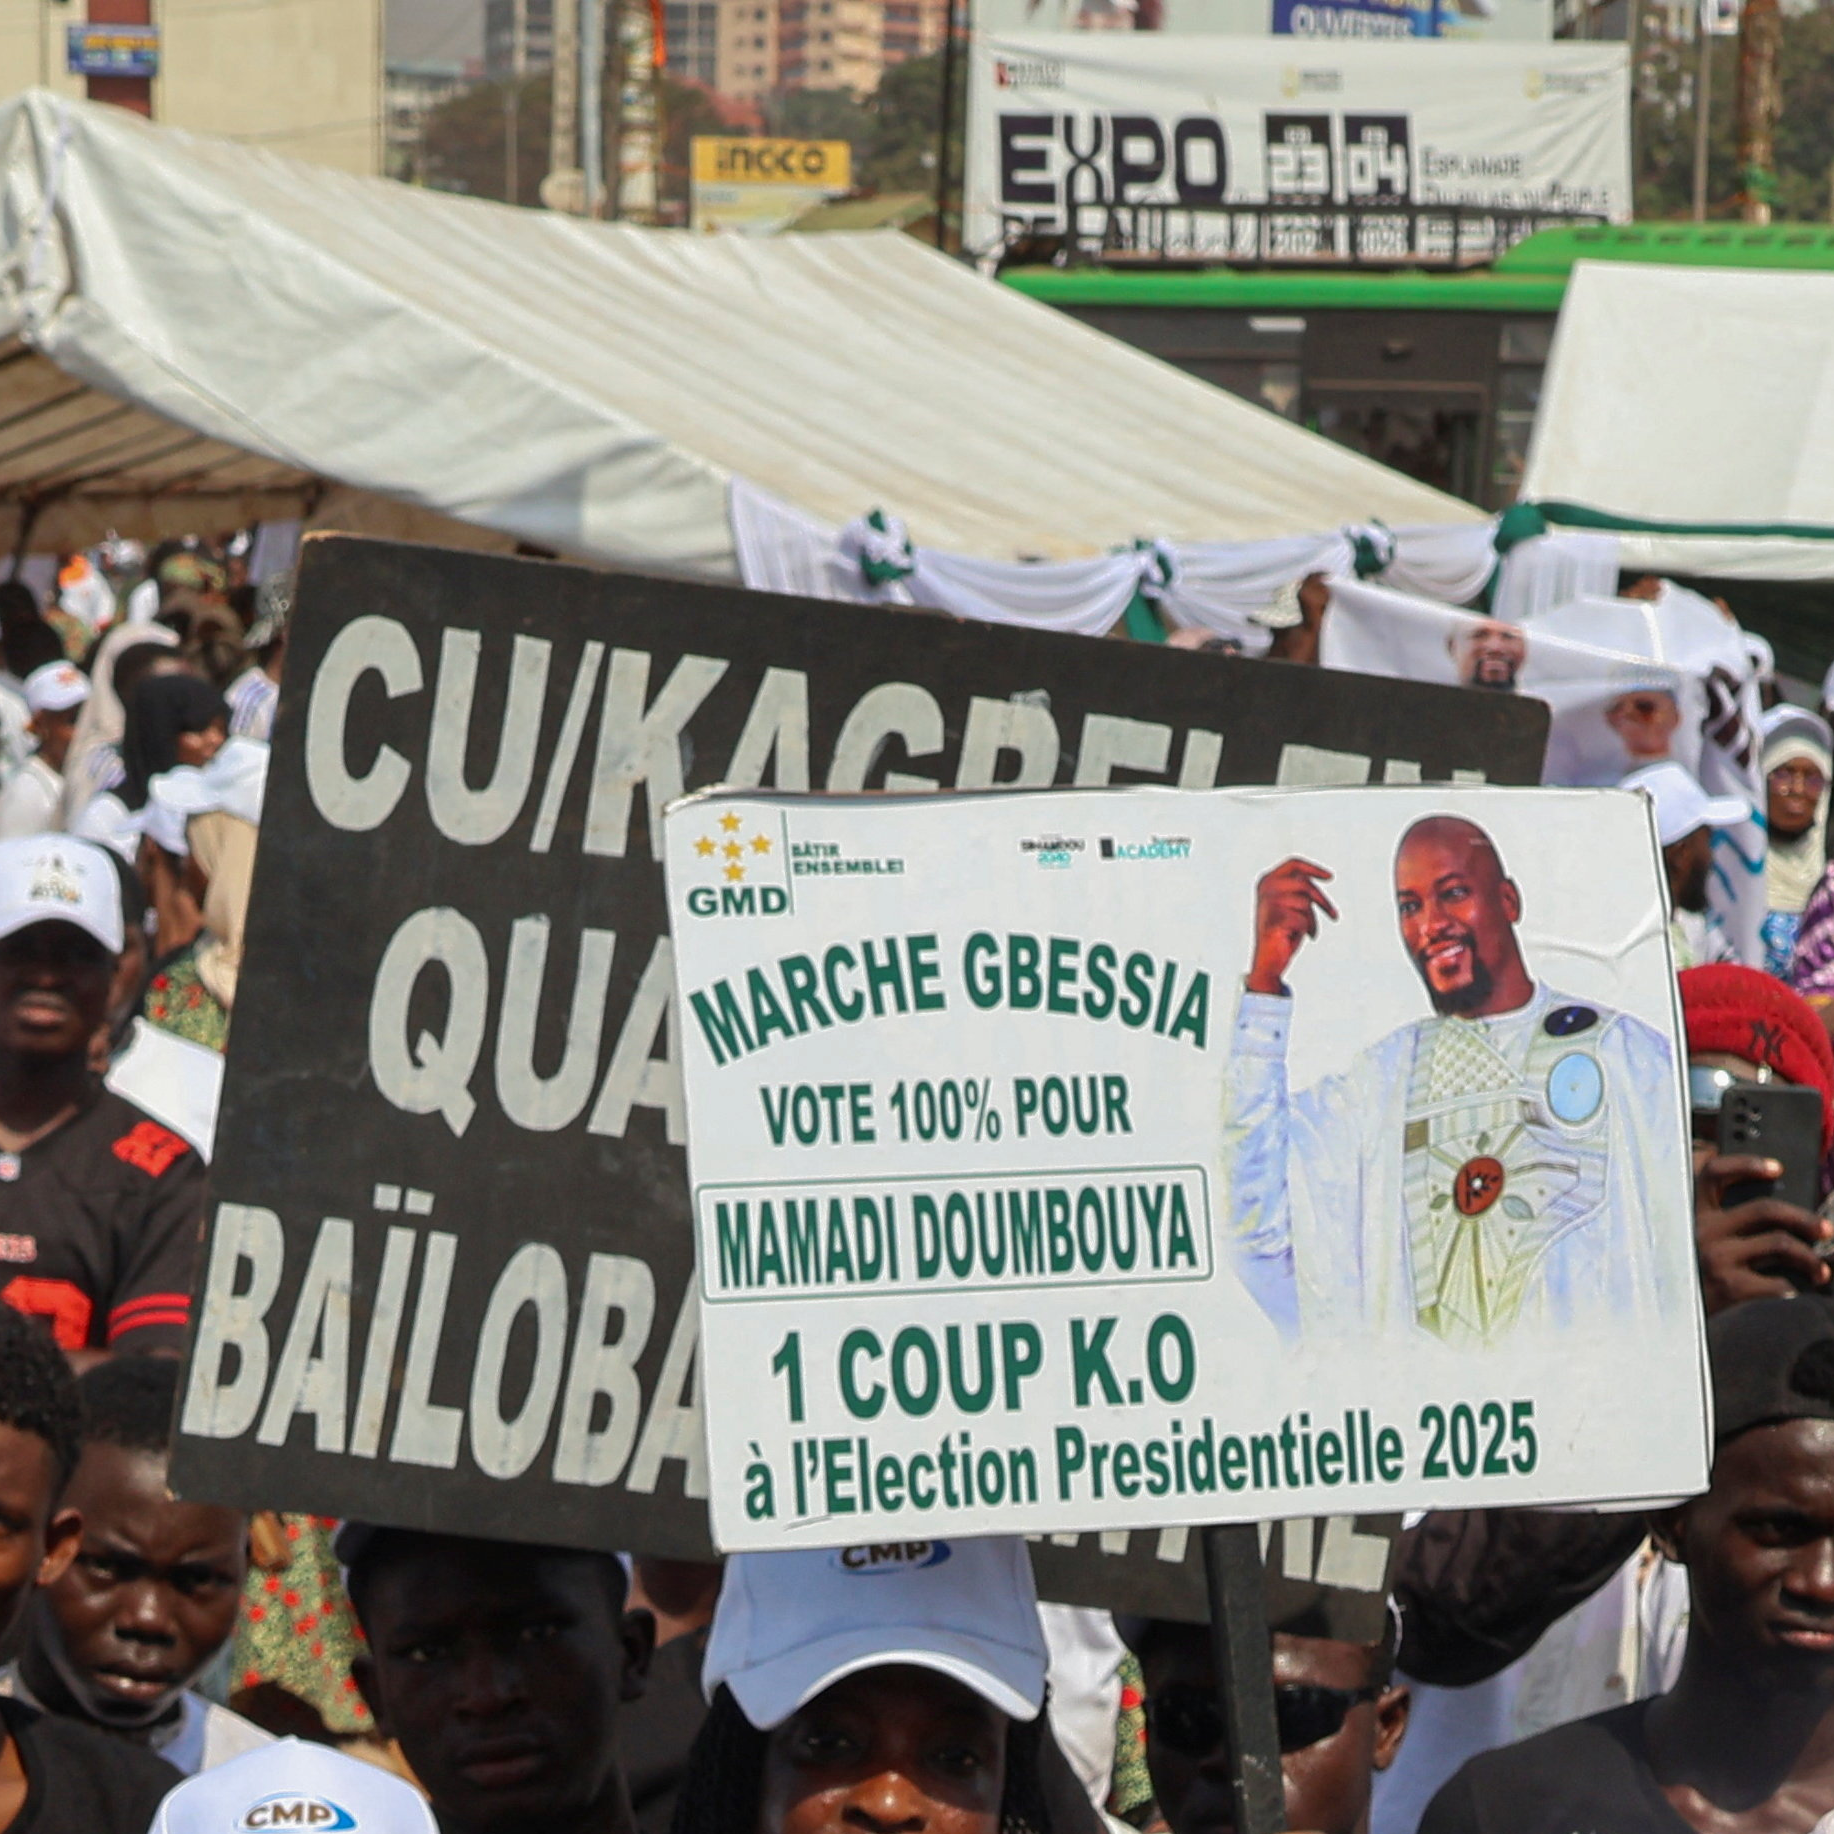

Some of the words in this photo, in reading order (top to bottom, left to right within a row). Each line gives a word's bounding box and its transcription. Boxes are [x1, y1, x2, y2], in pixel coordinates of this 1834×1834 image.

[1000, 114, 1226, 203] EXPO
[1269, 143, 1330, 195] 23
[1347, 143, 1408, 195] 04
[792, 841, 840, 859] BÂTIR
[1116, 843, 1192, 860] ACADEMY
[687, 885, 789, 919] GMD
[687, 931, 948, 1069] MARCHE
[963, 931, 1212, 1053] GBESSIA
[760, 1082, 878, 1148] VOTE
[887, 1075, 1003, 1142] 100%
[1013, 1073, 1133, 1138] POUR
[714, 1190, 901, 1292] MAMADI
[913, 1182, 1200, 1281] DOUMBOUYA
[771, 1333, 805, 1424] 1
[837, 1319, 1045, 1422] COUP
[1070, 1314, 1198, 1407] K.O
[745, 1439, 777, 1521] à
[792, 1433, 1042, 1519] l'Election
[1054, 1406, 1405, 1504] Presidentielle
[1420, 1400, 1540, 1481] 2025
[841, 1540, 934, 1572] CMP
[244, 1801, 333, 1830] CMP
